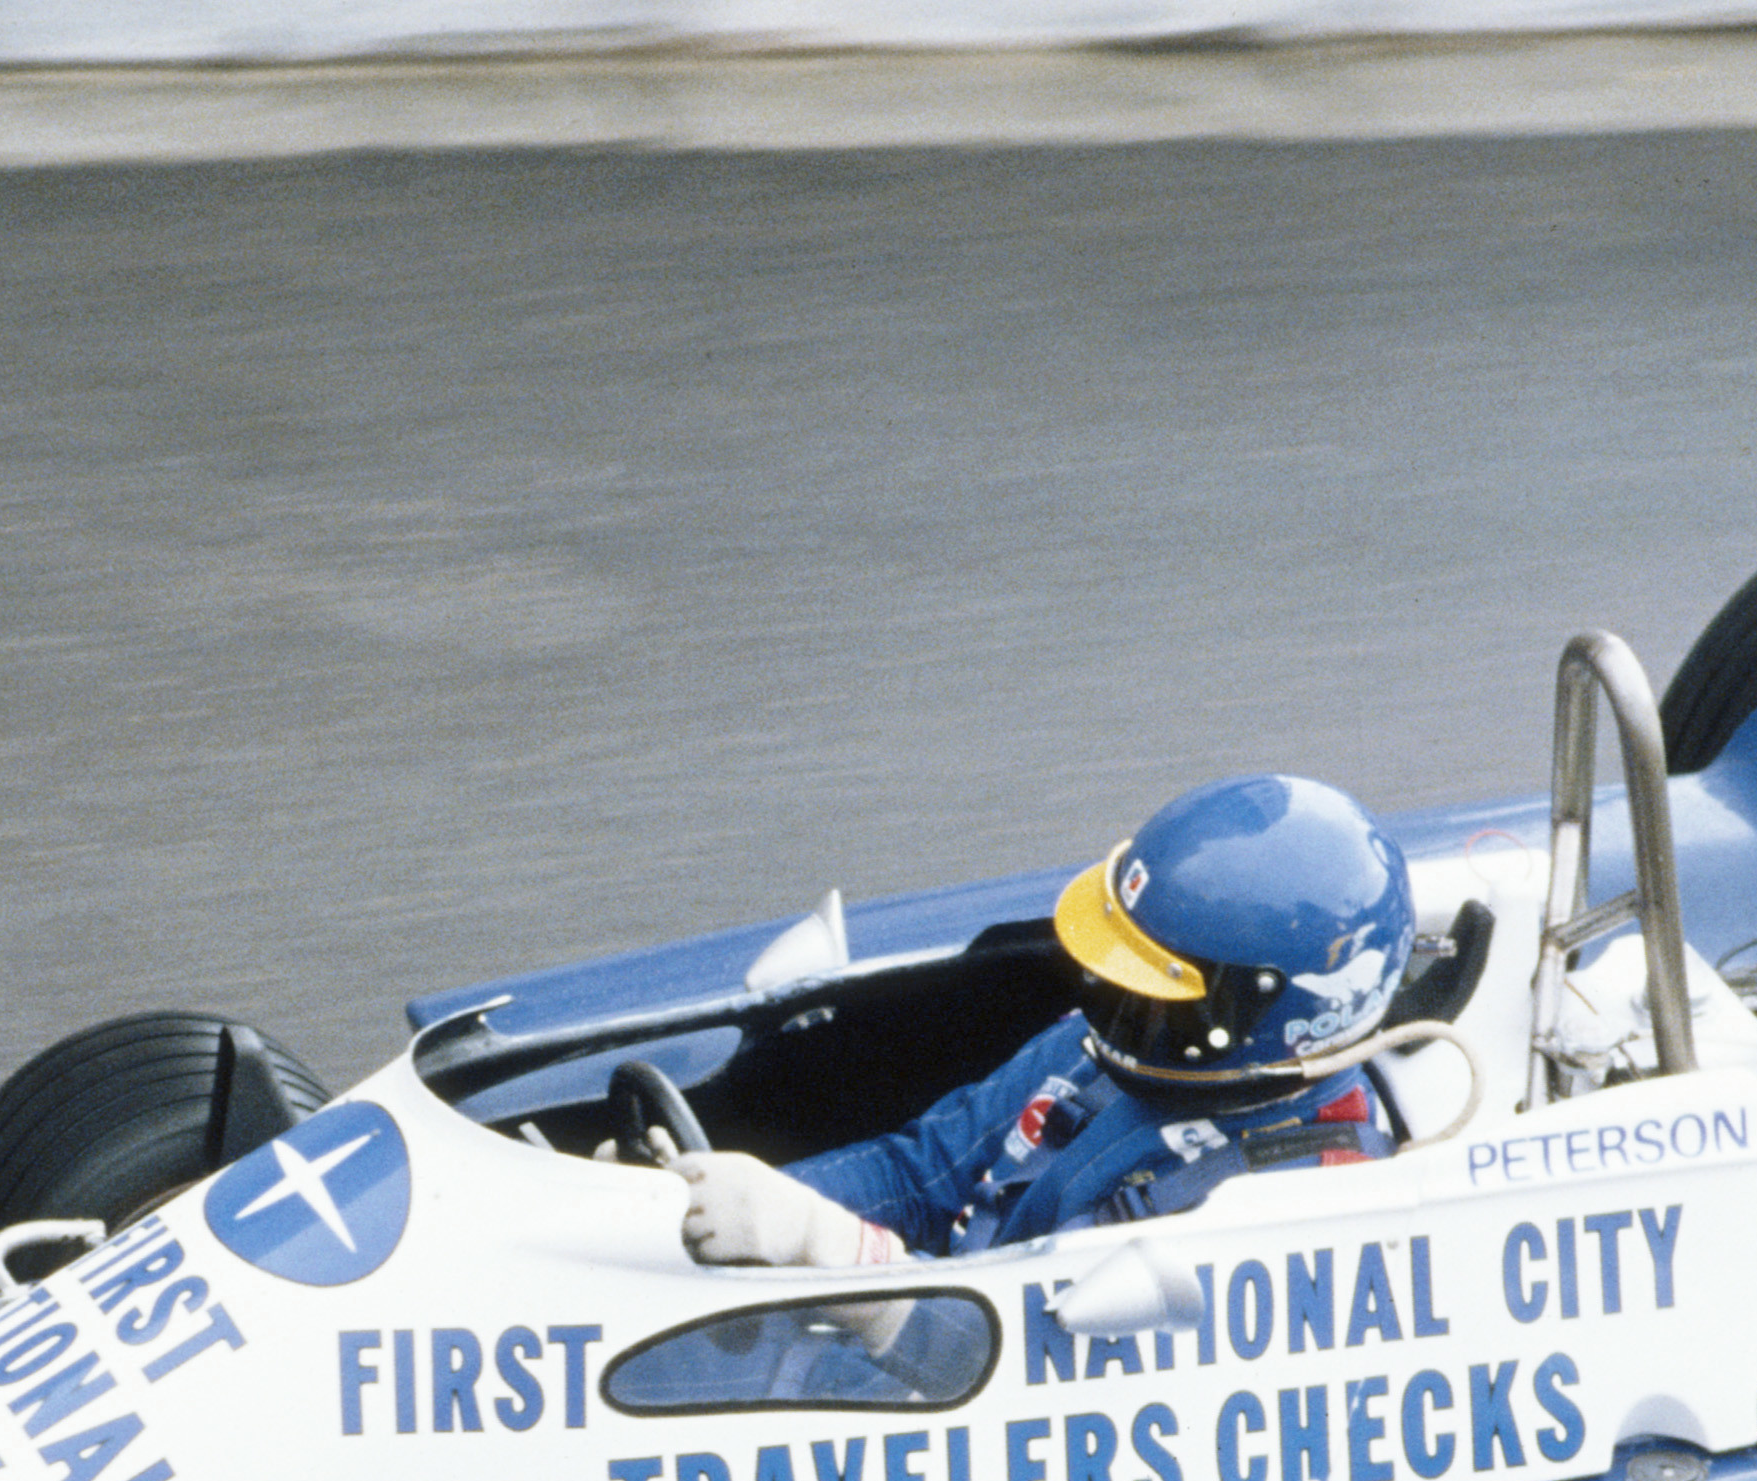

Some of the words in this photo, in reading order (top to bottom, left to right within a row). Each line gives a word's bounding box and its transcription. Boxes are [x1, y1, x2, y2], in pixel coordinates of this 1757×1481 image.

[1284, 972, 1398, 1046] POLA
[1468, 1106, 1750, 1187] PETERSON
[338, 1323, 603, 1435] FIRST
[1502, 1204, 1684, 1324] CITY
